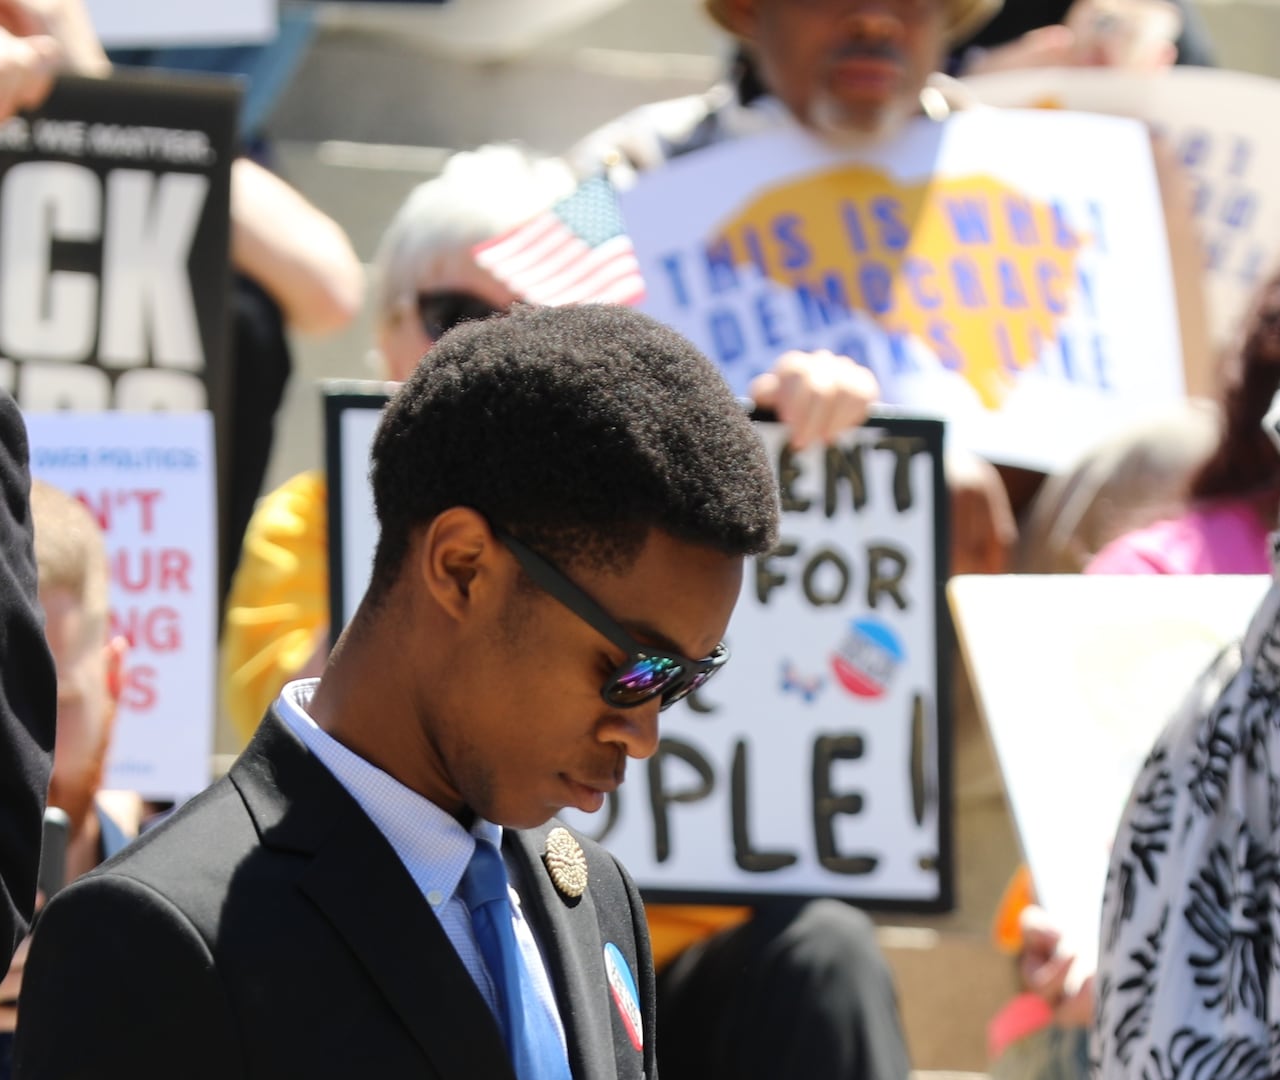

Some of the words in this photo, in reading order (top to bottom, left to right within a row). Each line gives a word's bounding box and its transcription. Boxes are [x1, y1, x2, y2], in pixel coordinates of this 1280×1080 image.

[658, 210, 811, 306] THIS
[842, 194, 910, 253] IS
[942, 199, 1109, 256] WHAT
[754, 540, 910, 610] FOR
